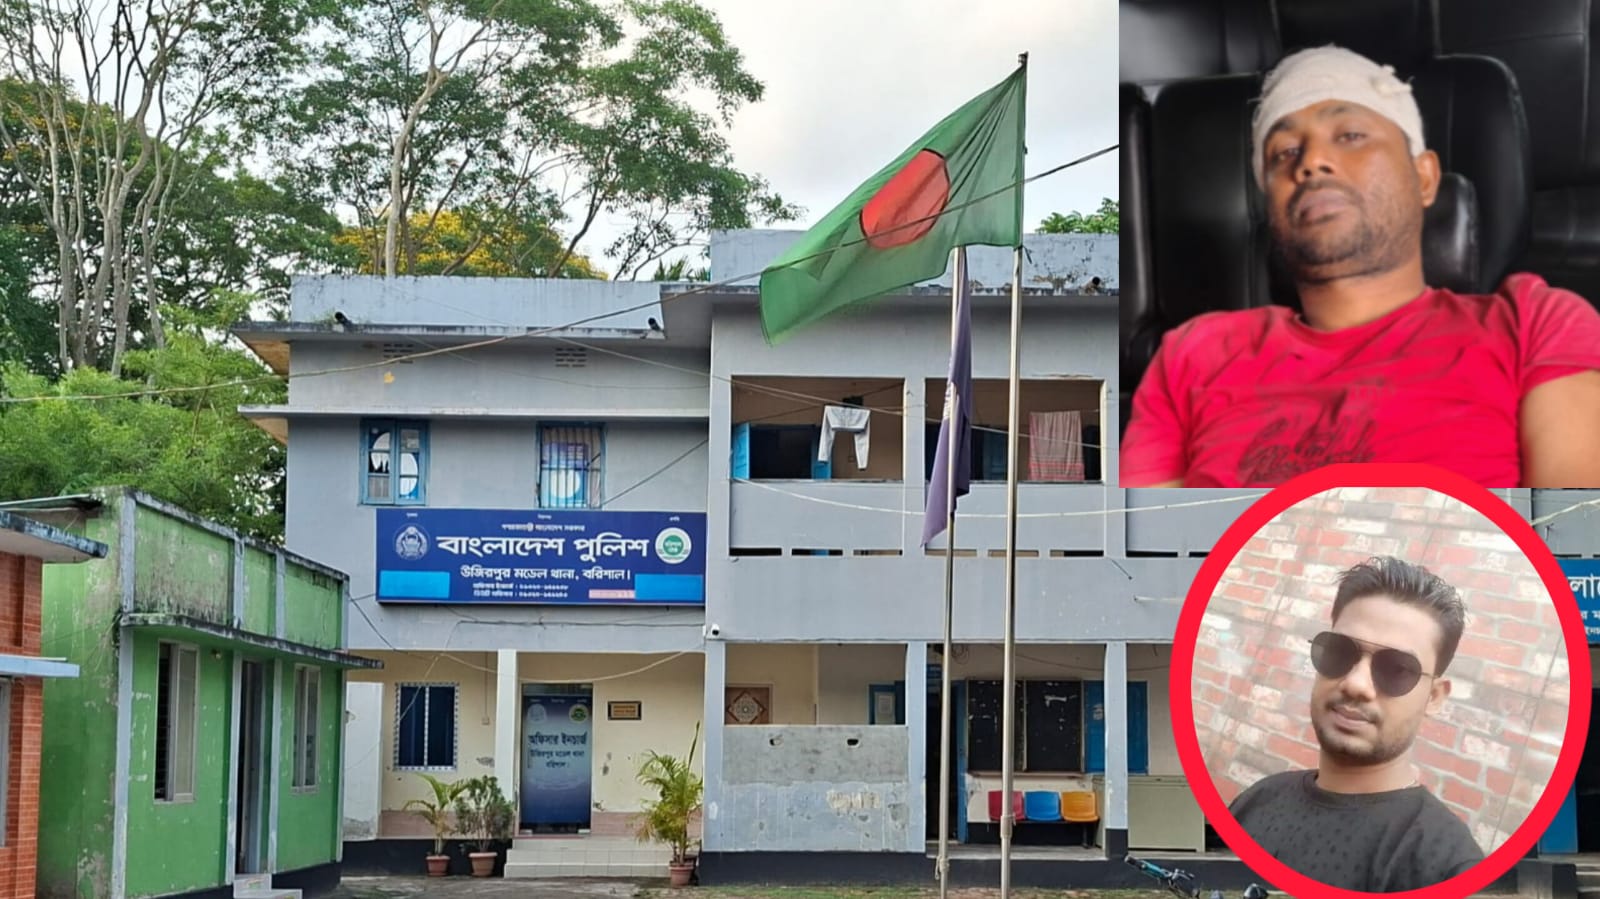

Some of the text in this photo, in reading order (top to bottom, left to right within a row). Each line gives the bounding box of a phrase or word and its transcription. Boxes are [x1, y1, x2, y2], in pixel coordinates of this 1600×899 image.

[435, 536, 566, 557] বাংলাদেশ
[573, 532, 650, 562] পুলিশ
[460, 564, 511, 581] উজিরপুর
[514, 567, 548, 579] মডেল
[550, 568, 580, 581] থানা,
[528, 731, 559, 745] অফিসার
